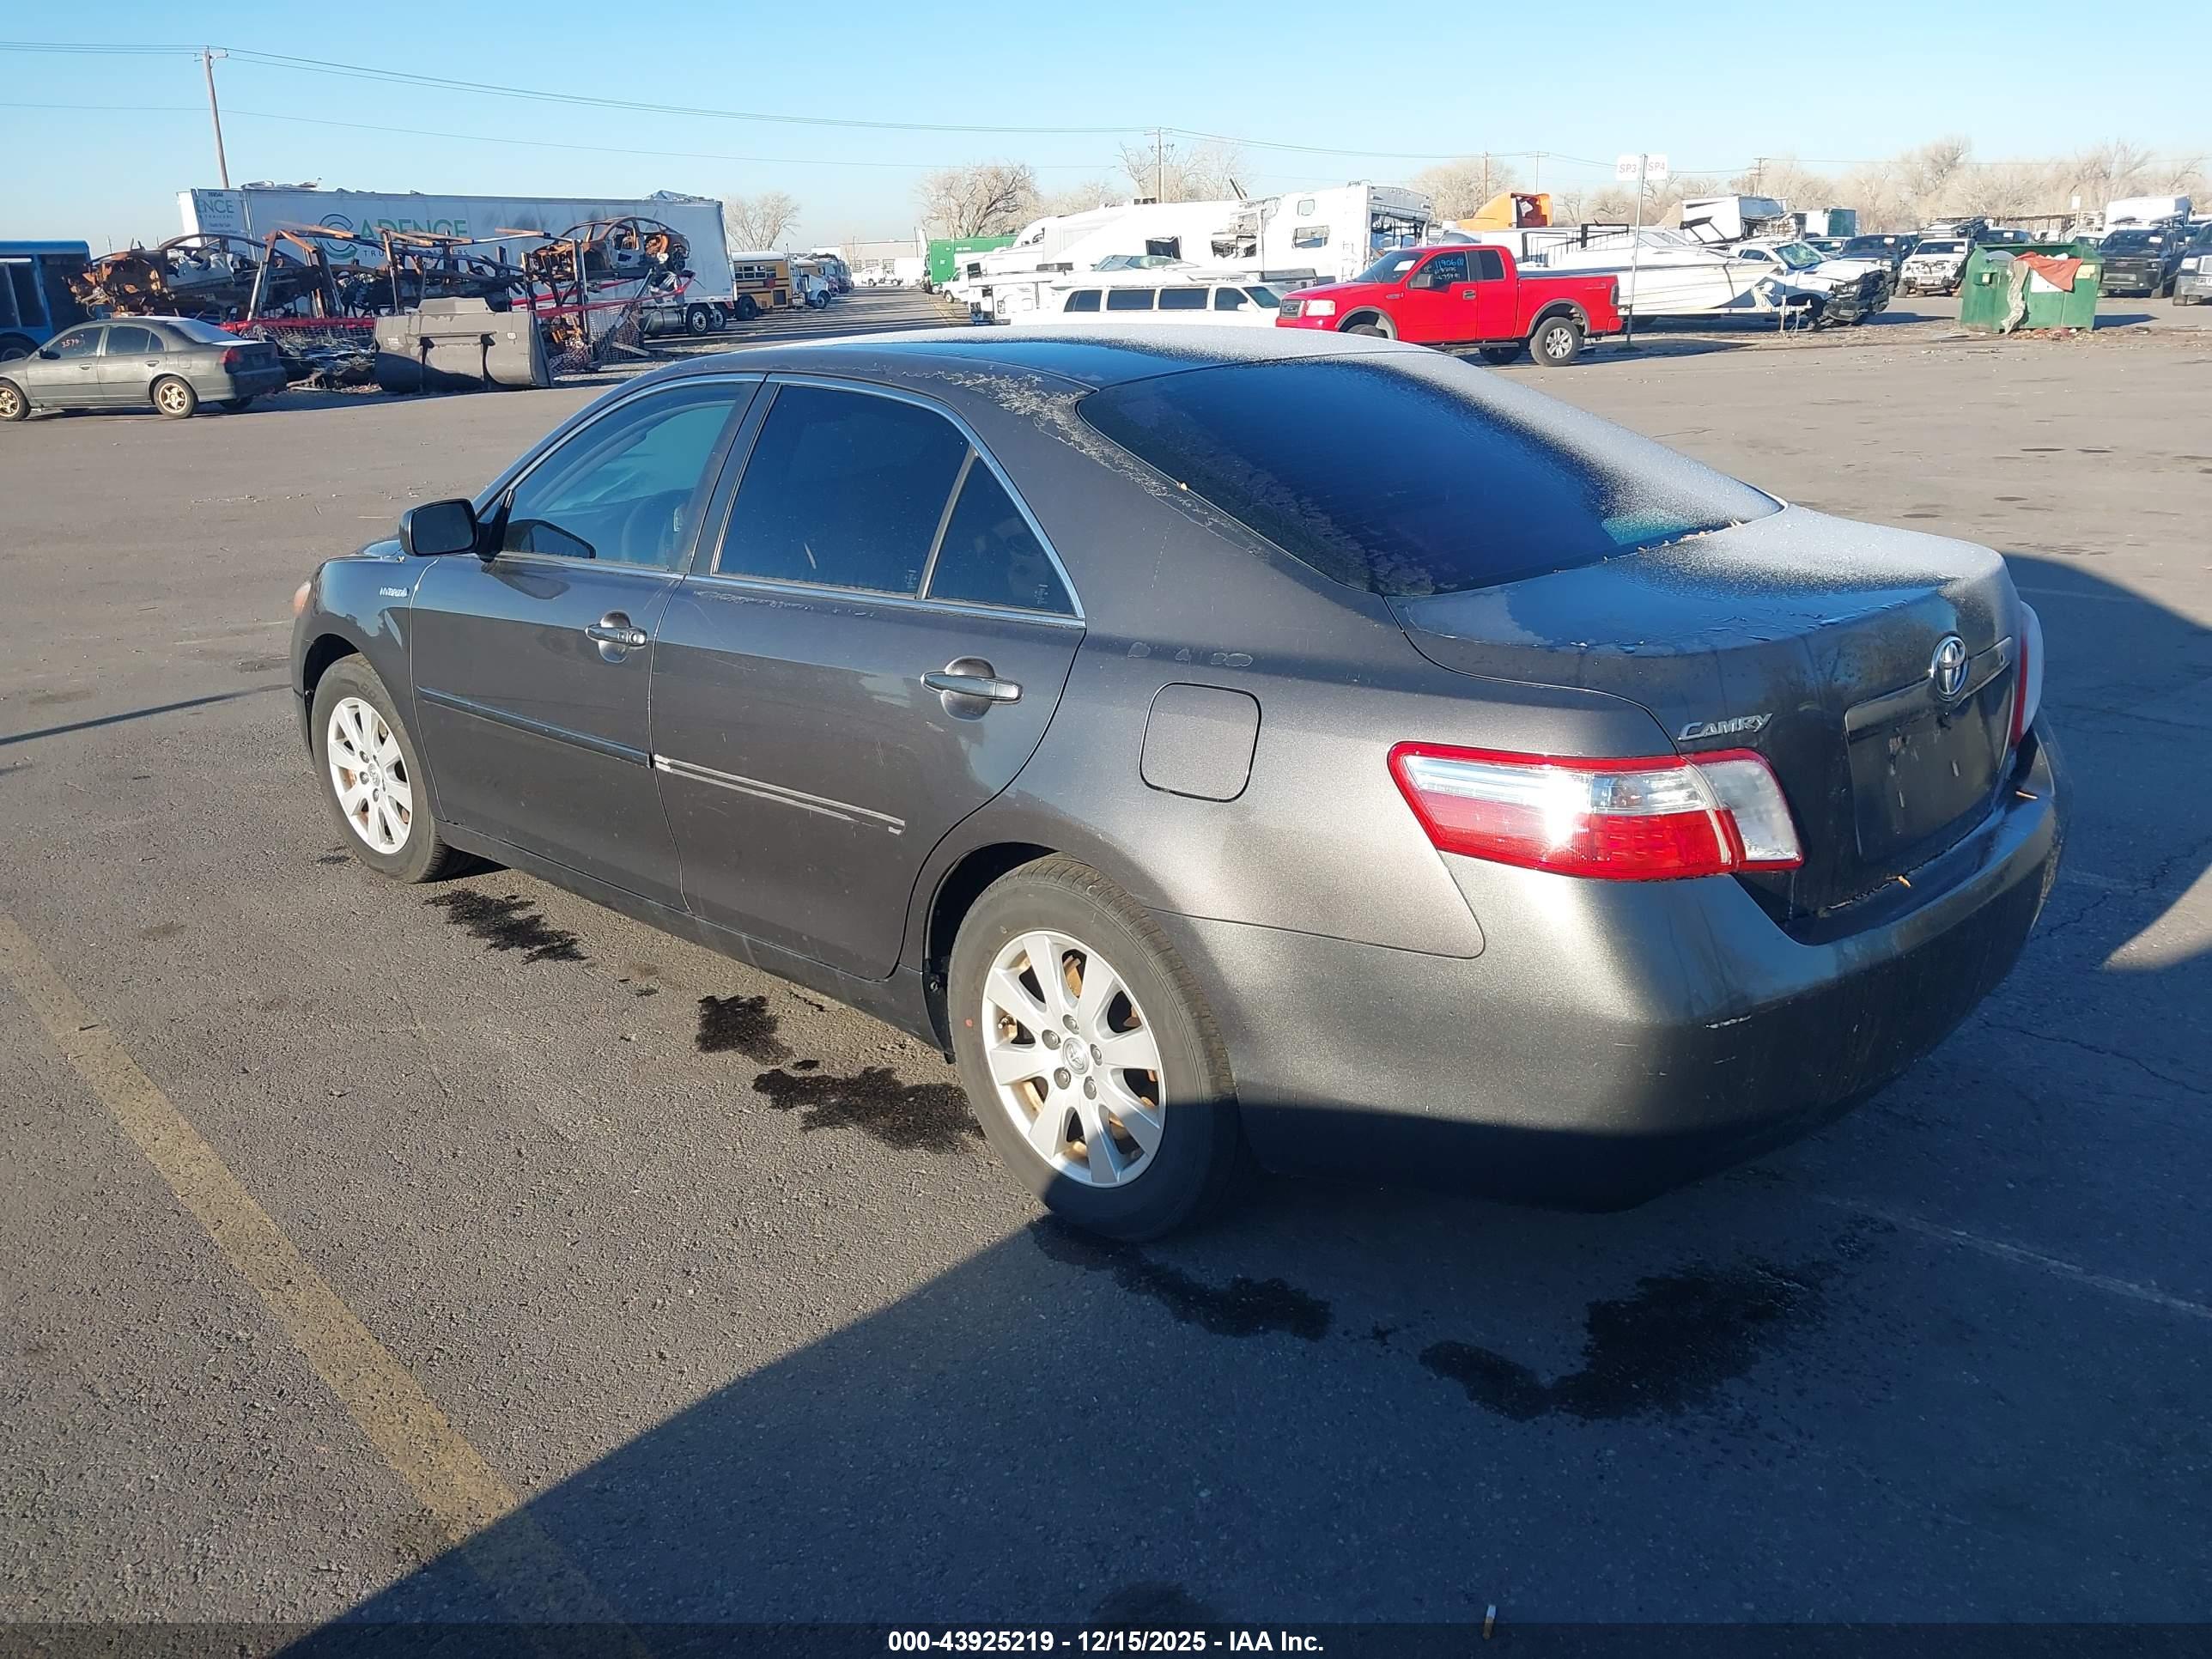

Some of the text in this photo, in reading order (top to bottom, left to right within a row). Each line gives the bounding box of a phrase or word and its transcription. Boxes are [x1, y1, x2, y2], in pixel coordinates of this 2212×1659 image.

[1619, 163, 1638, 173] SP3
[1648, 161, 1666, 172] SP4
[1677, 713, 1773, 742] CAMRY
